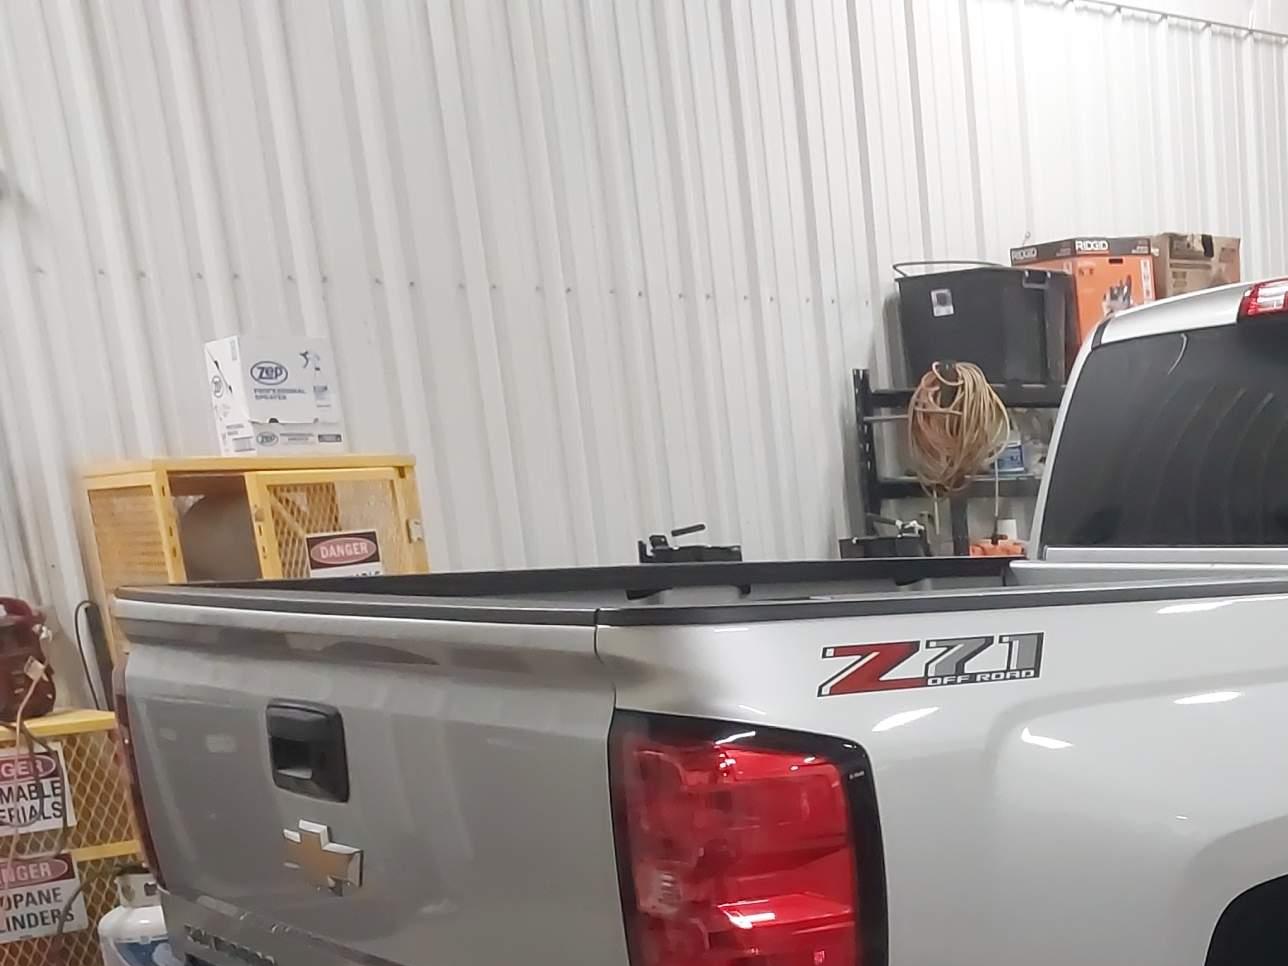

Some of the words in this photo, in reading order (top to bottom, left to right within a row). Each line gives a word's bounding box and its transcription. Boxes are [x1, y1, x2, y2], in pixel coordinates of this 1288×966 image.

[1012, 247, 1037, 259] RIDGID
[1075, 240, 1108, 250] RIDGID
[320, 542, 369, 559] DANGER
[817, 632, 1044, 697] Z71
[927, 675, 970, 686] OFF
[976, 669, 1035, 682] ROAD
[1, 760, 44, 777] GER
[0, 781, 61, 804] MABLE
[0, 801, 63, 824] ERIALS
[0, 862, 52, 882] NGER
